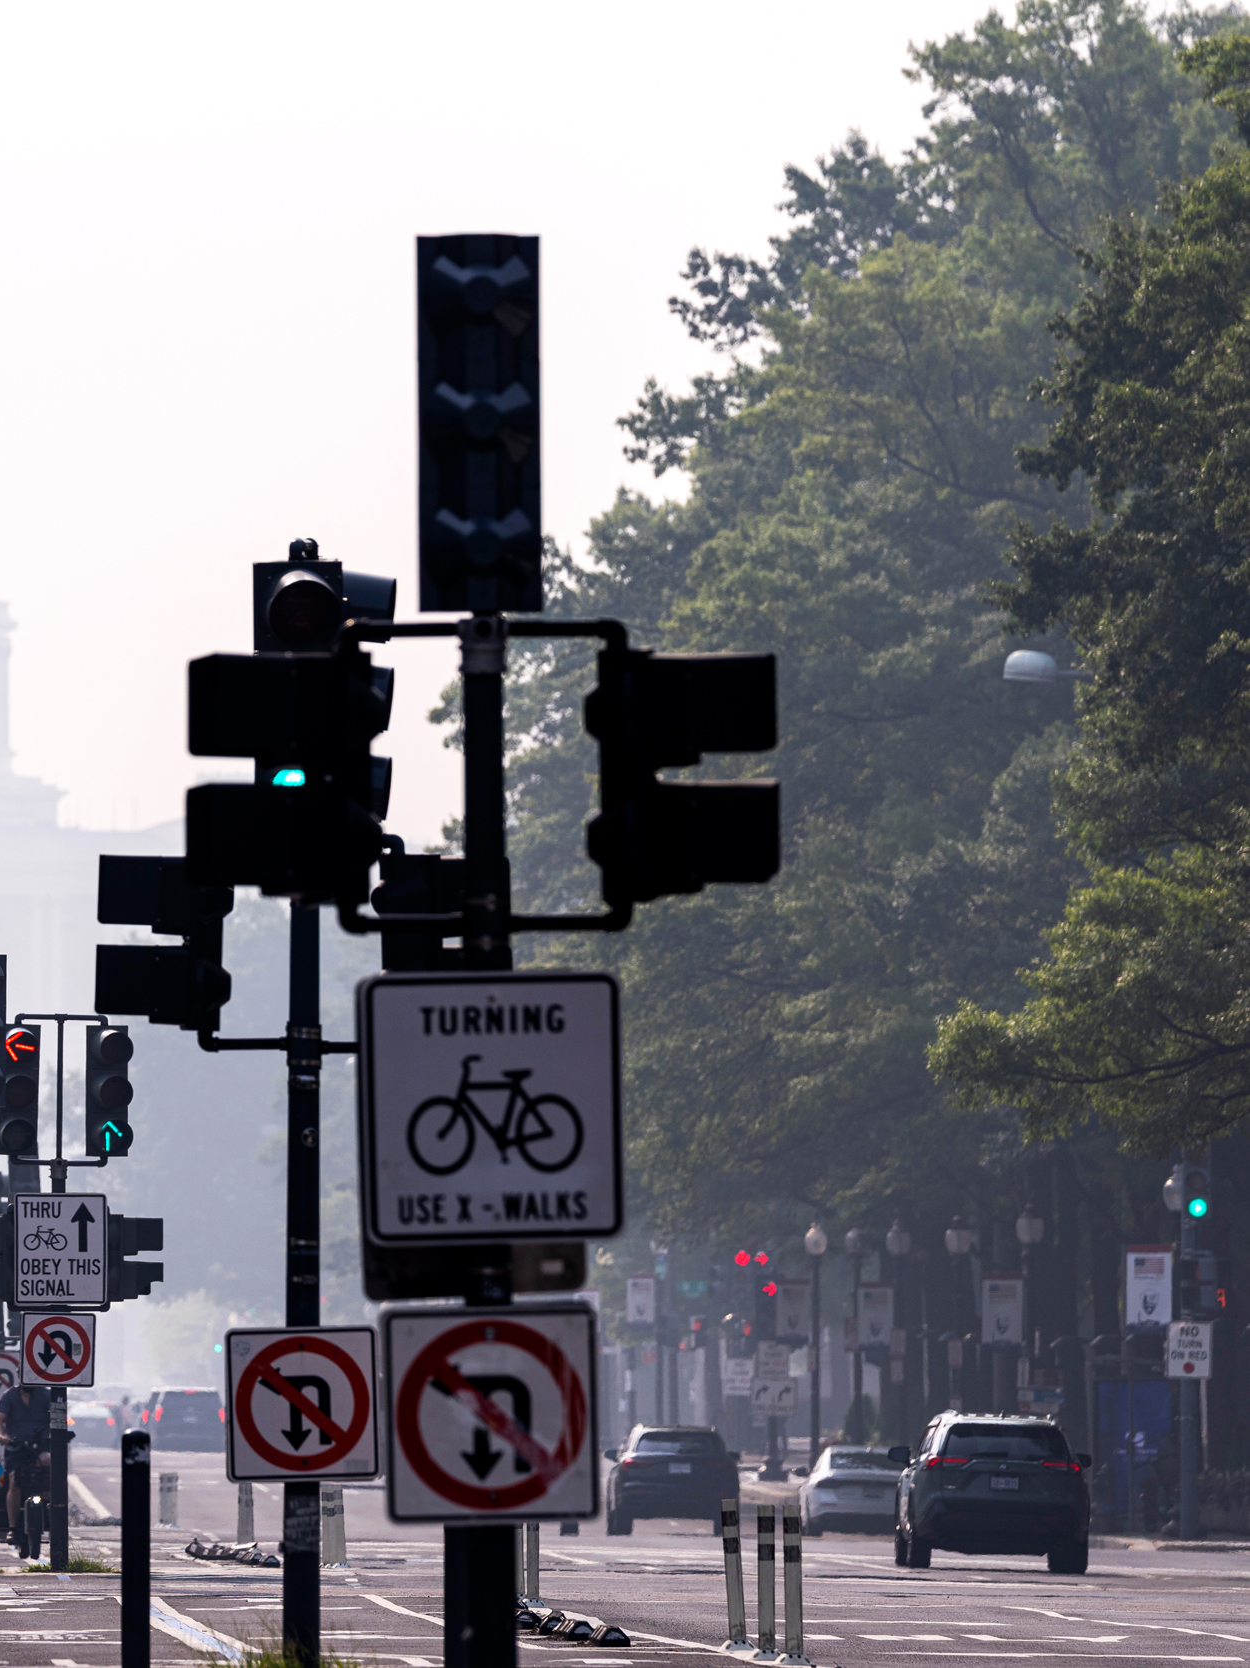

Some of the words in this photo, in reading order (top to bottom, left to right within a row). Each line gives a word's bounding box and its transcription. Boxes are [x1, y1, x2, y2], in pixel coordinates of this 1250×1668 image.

[420, 1003, 566, 1036] TURNING
[21, 1201, 61, 1219] THRU
[397, 1193, 448, 1225] USE
[20, 1258, 61, 1275] OBEY
[68, 1258, 101, 1275] THIS
[20, 1279, 75, 1297] SIGNAL
[1179, 1326, 1200, 1338] NO
[1177, 1339, 1203, 1349] TURN
[1171, 1350, 1185, 1361] ON
[1188, 1350, 1208, 1361] RED
